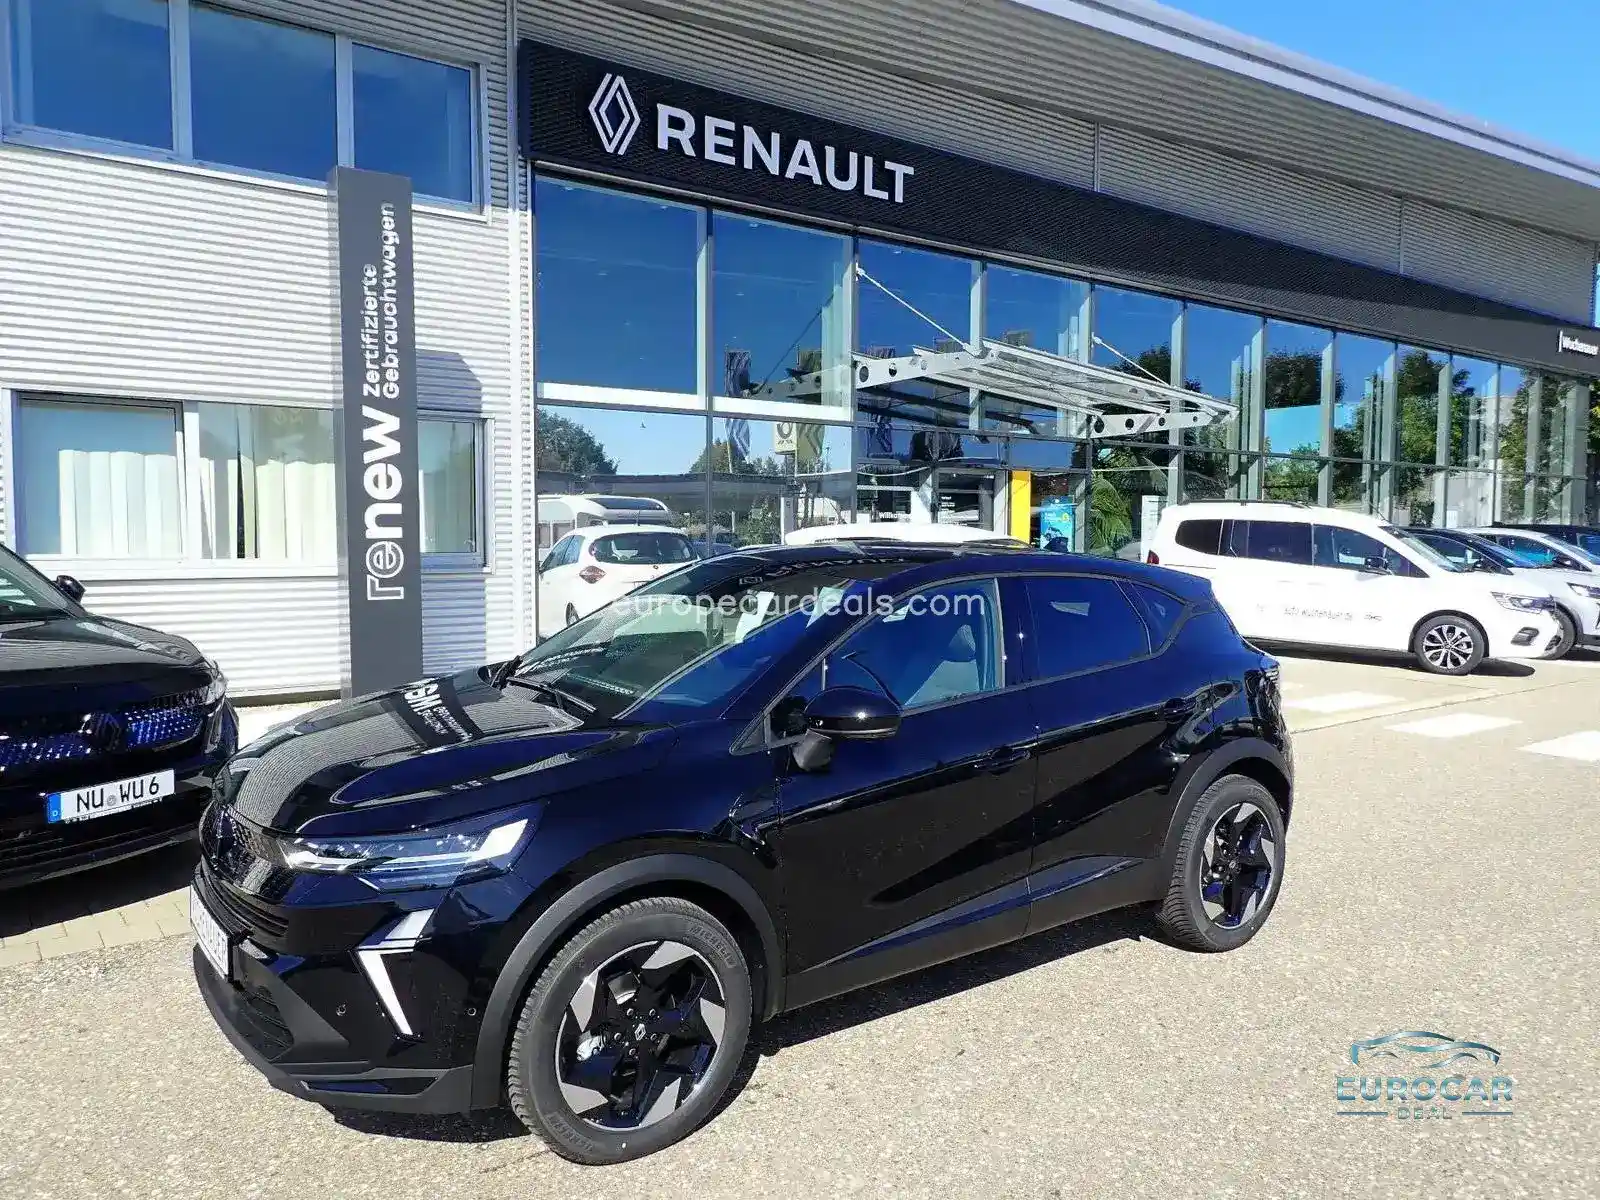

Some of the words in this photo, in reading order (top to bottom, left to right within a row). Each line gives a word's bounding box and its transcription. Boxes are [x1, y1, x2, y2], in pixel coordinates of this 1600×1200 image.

[656, 102, 915, 203] RENAULT
[361, 263, 380, 398] Zertifizierte
[379, 202, 400, 399] Gebrauchtwagen
[362, 405, 404, 600] renew
[76, 788, 105, 812] NU
[119, 779, 144, 803] WU
[148, 776, 160, 795] 6
